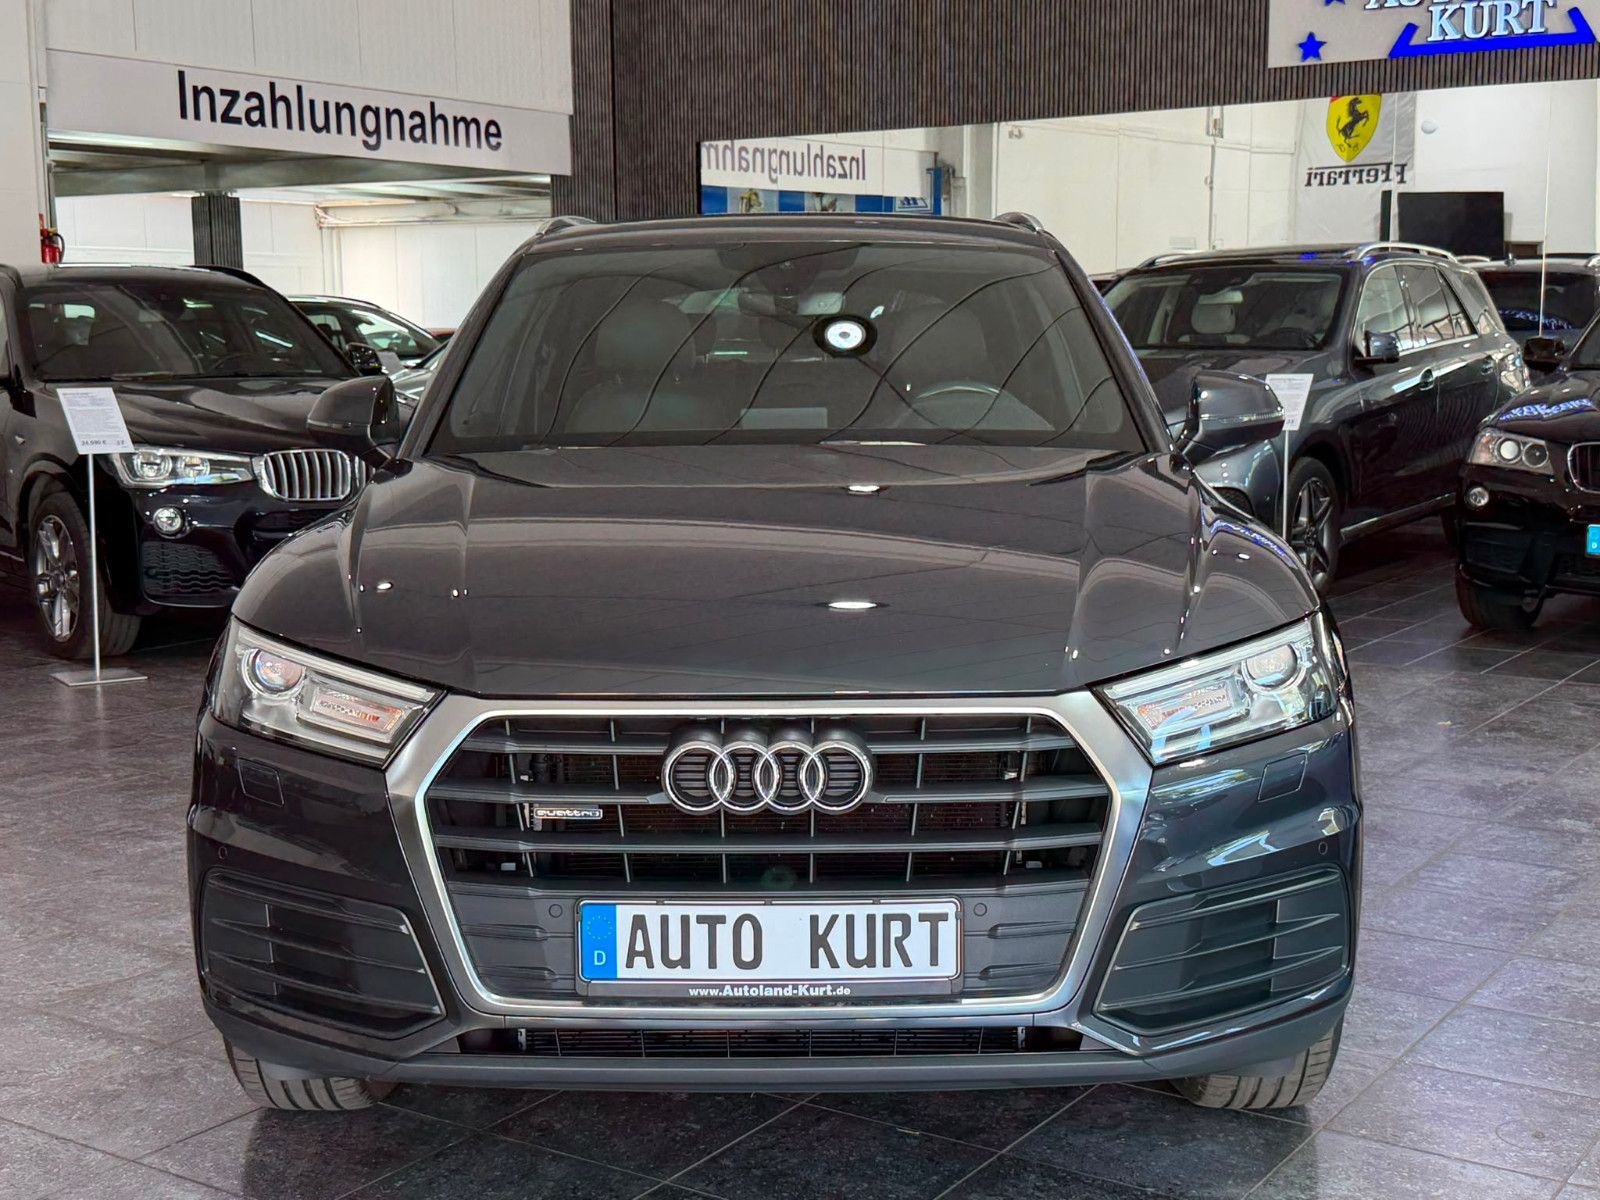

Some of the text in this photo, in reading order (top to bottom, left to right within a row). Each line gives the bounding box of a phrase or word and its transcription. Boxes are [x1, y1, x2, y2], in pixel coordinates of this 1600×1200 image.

[1427, 1, 1557, 42] KURT
[177, 70, 502, 151] Inzahlungnahme
[536, 809, 600, 818] quattro
[625, 911, 949, 970] AUTO KURT
[593, 950, 606, 966] D
[688, 984, 851, 997] www.Autoland-Kurt.de
